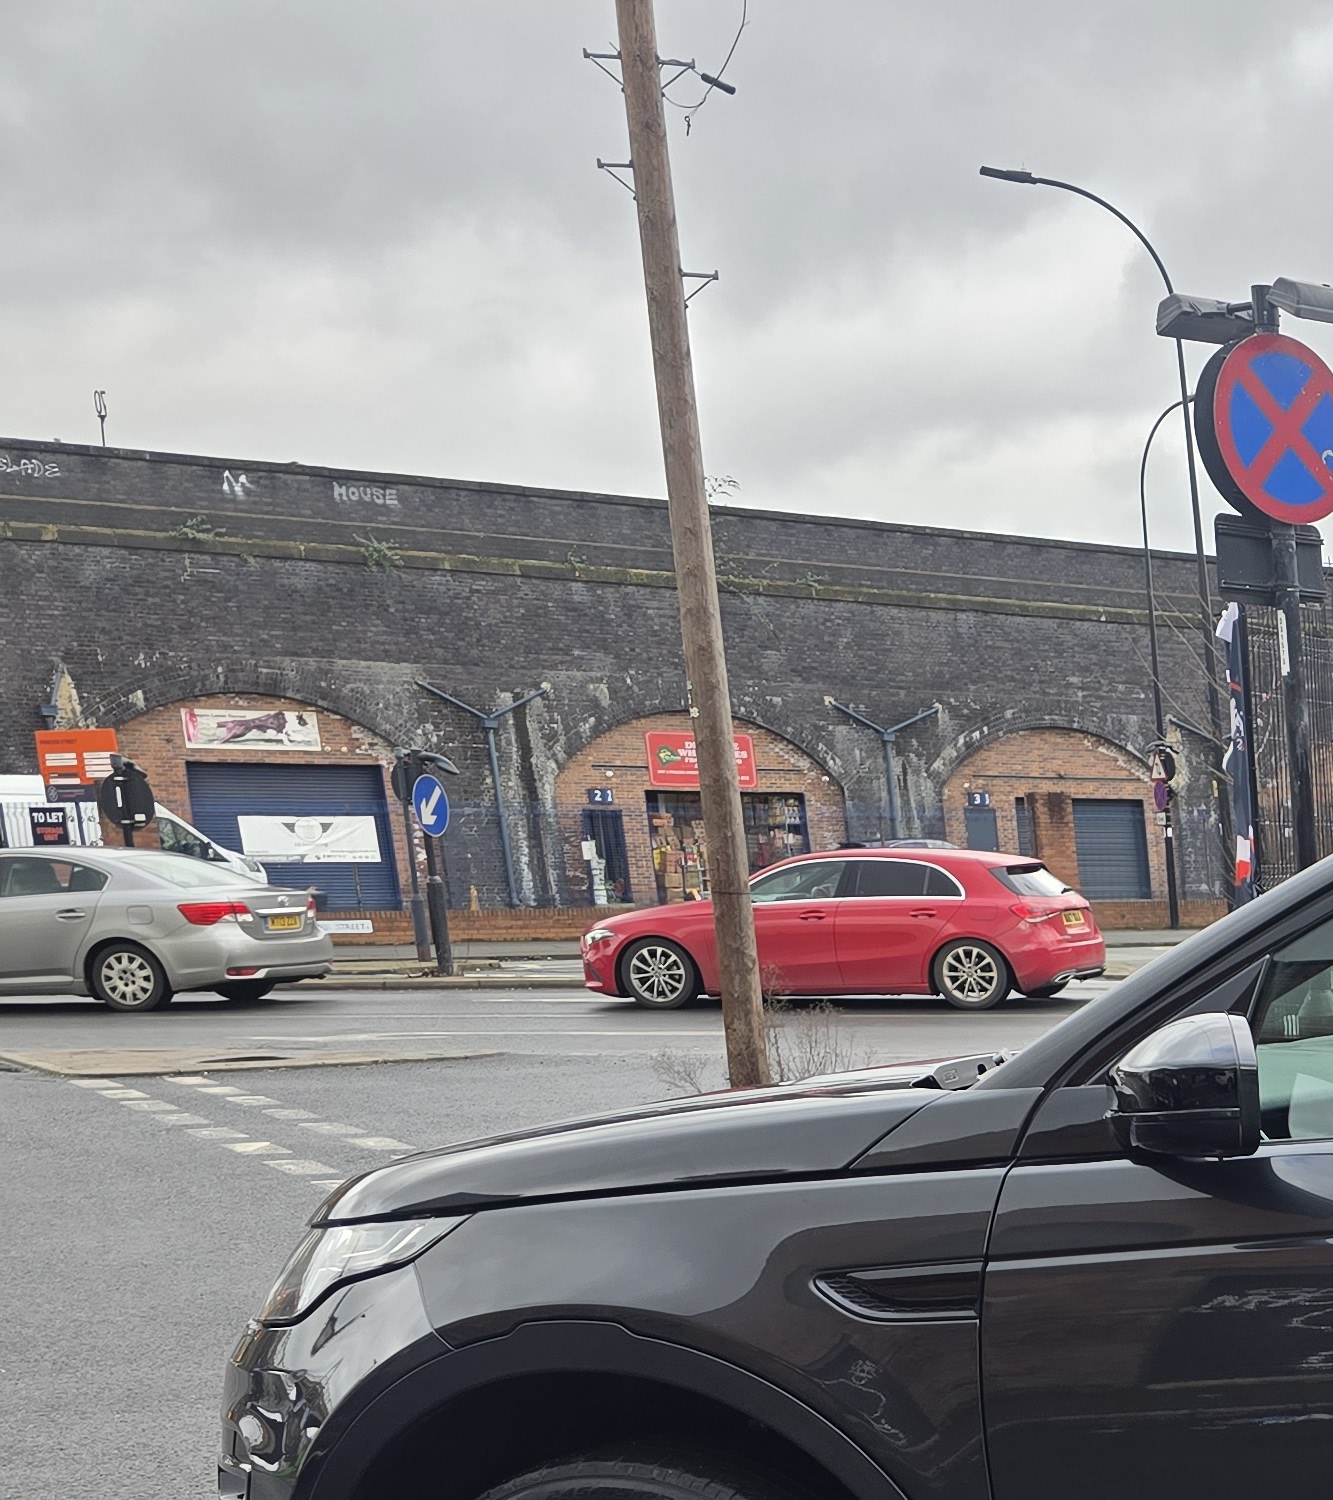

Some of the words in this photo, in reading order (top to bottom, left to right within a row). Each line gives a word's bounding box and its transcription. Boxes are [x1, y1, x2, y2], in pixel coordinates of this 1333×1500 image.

[333, 481, 399, 505] MOUSE
[594, 790, 613, 801] 21
[974, 794, 989, 804] 31
[32, 812, 45, 823] TO
[46, 812, 64, 823] LET
